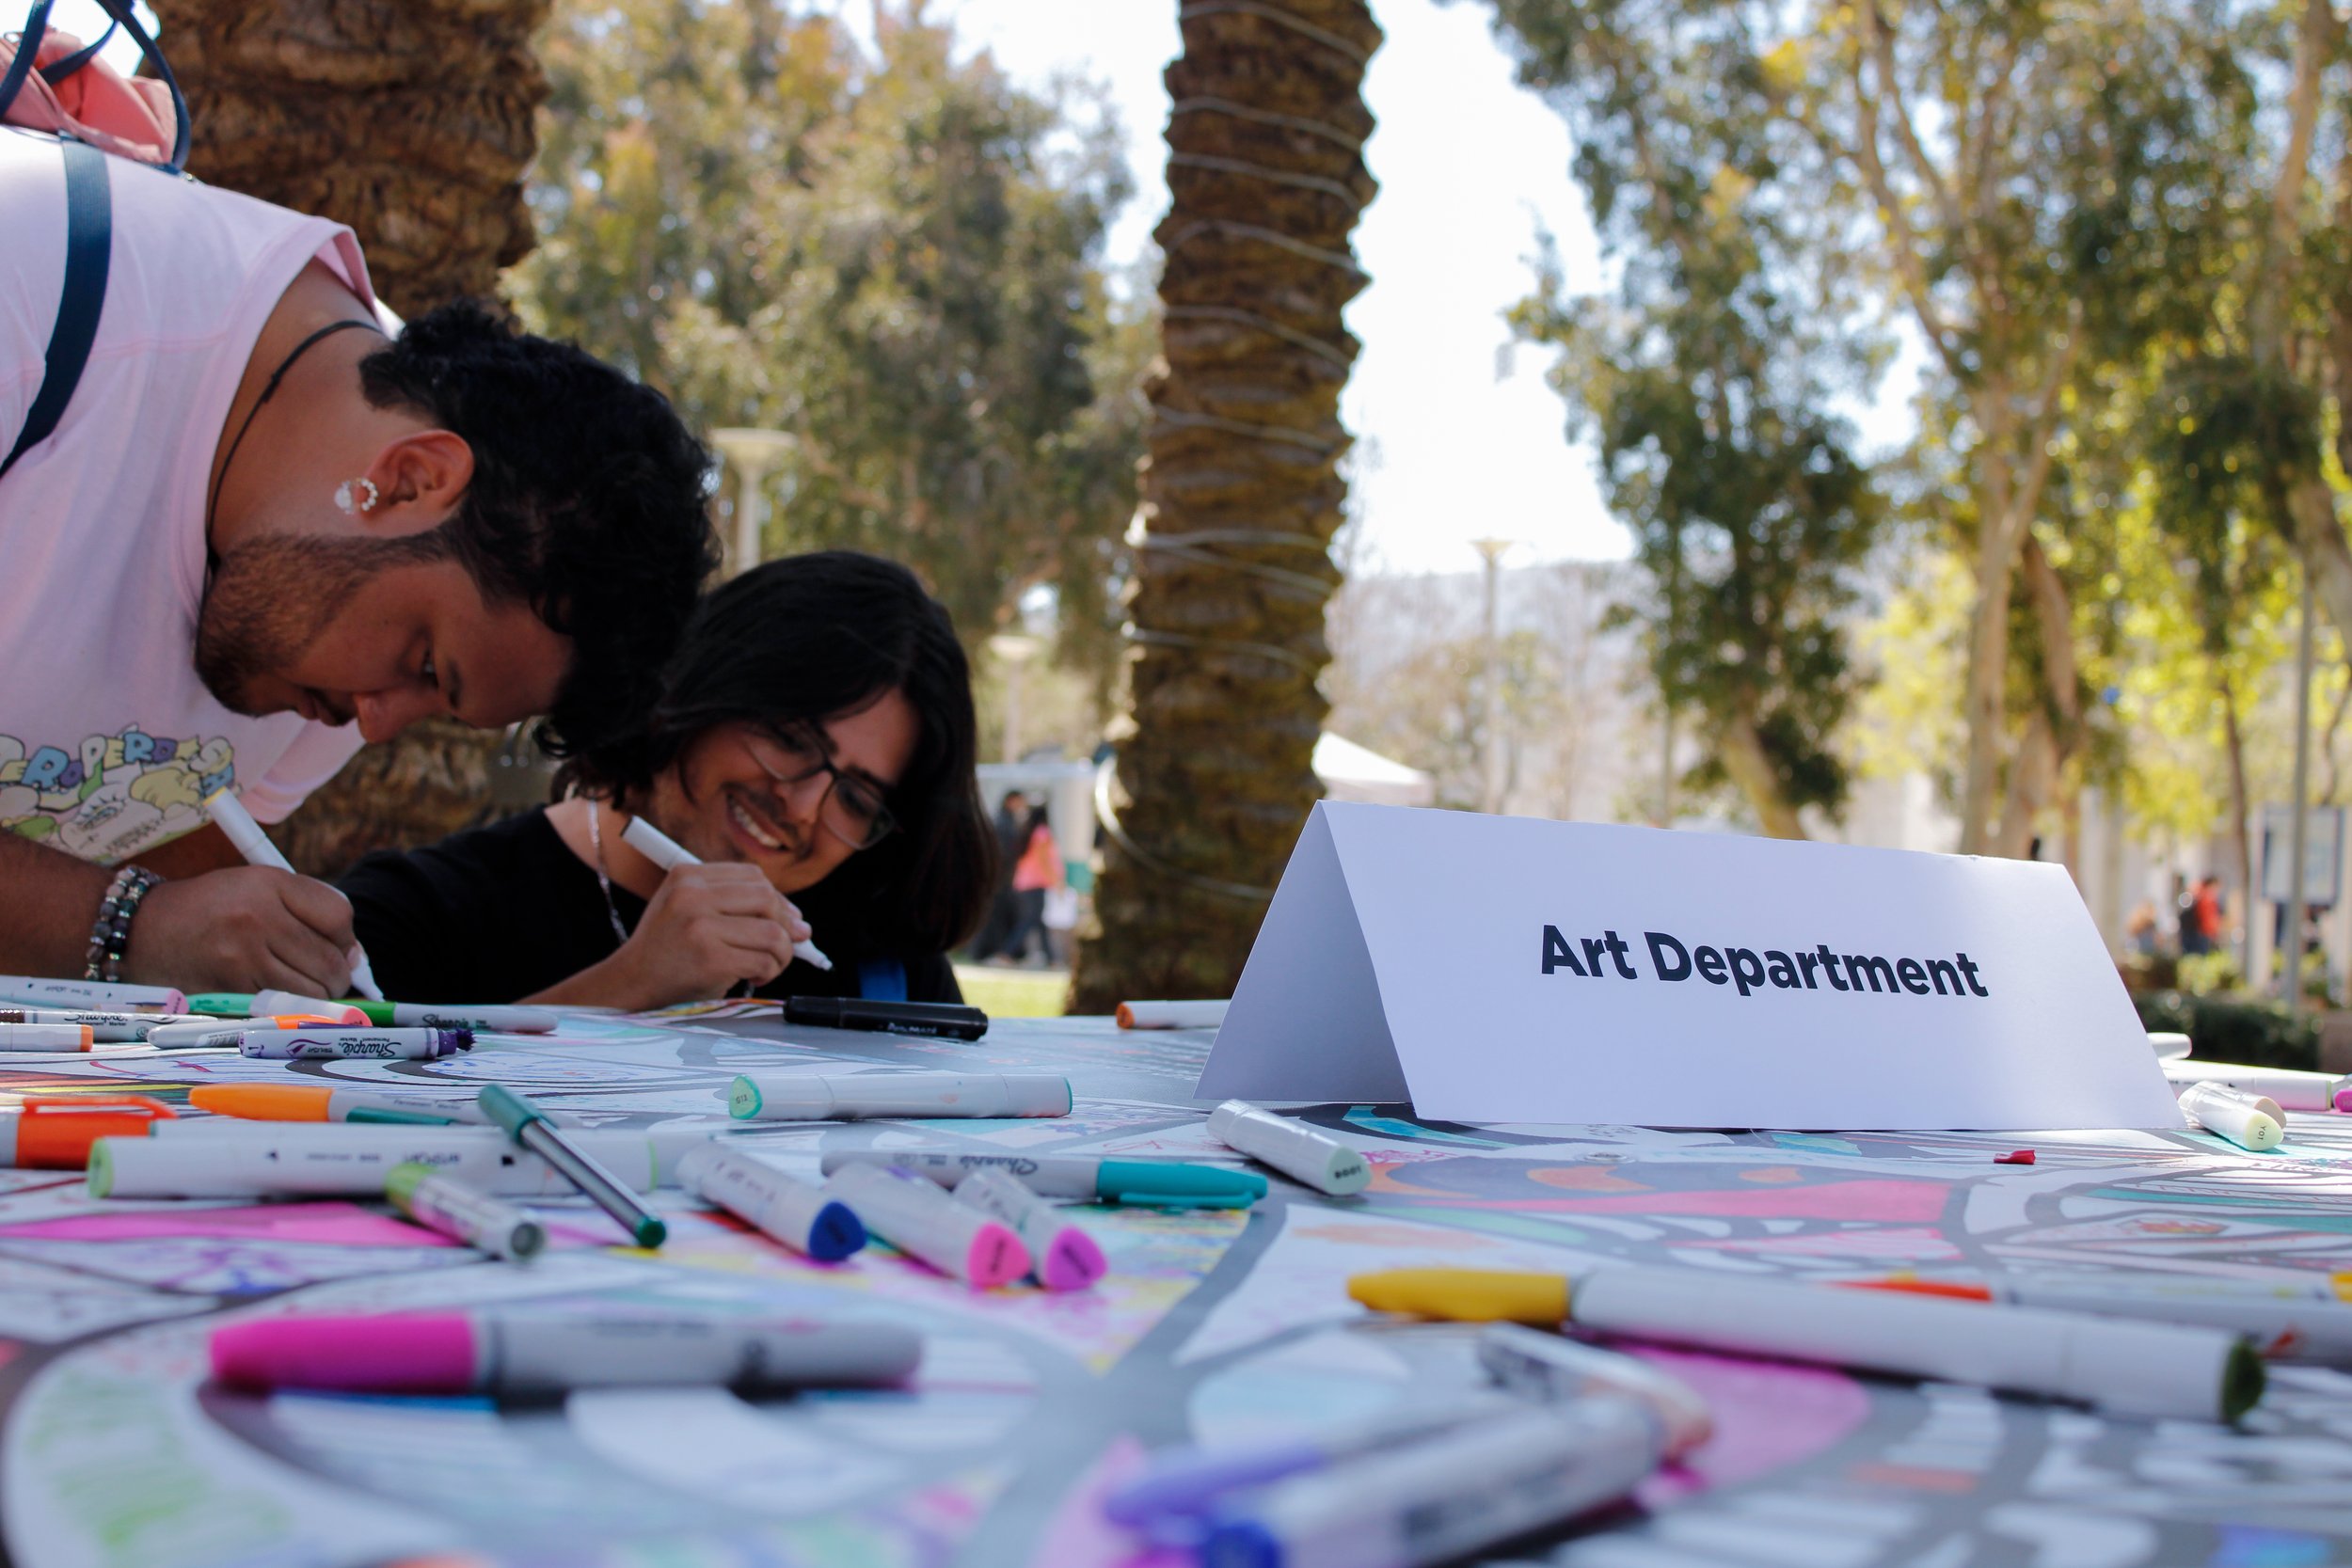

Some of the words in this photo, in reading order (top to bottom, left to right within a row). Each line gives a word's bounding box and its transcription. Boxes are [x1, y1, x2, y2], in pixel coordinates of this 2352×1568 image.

[1541, 925, 1638, 980] Art
[1644, 931, 1989, 997] Department
[340, 1041, 402, 1058] Sharpie
